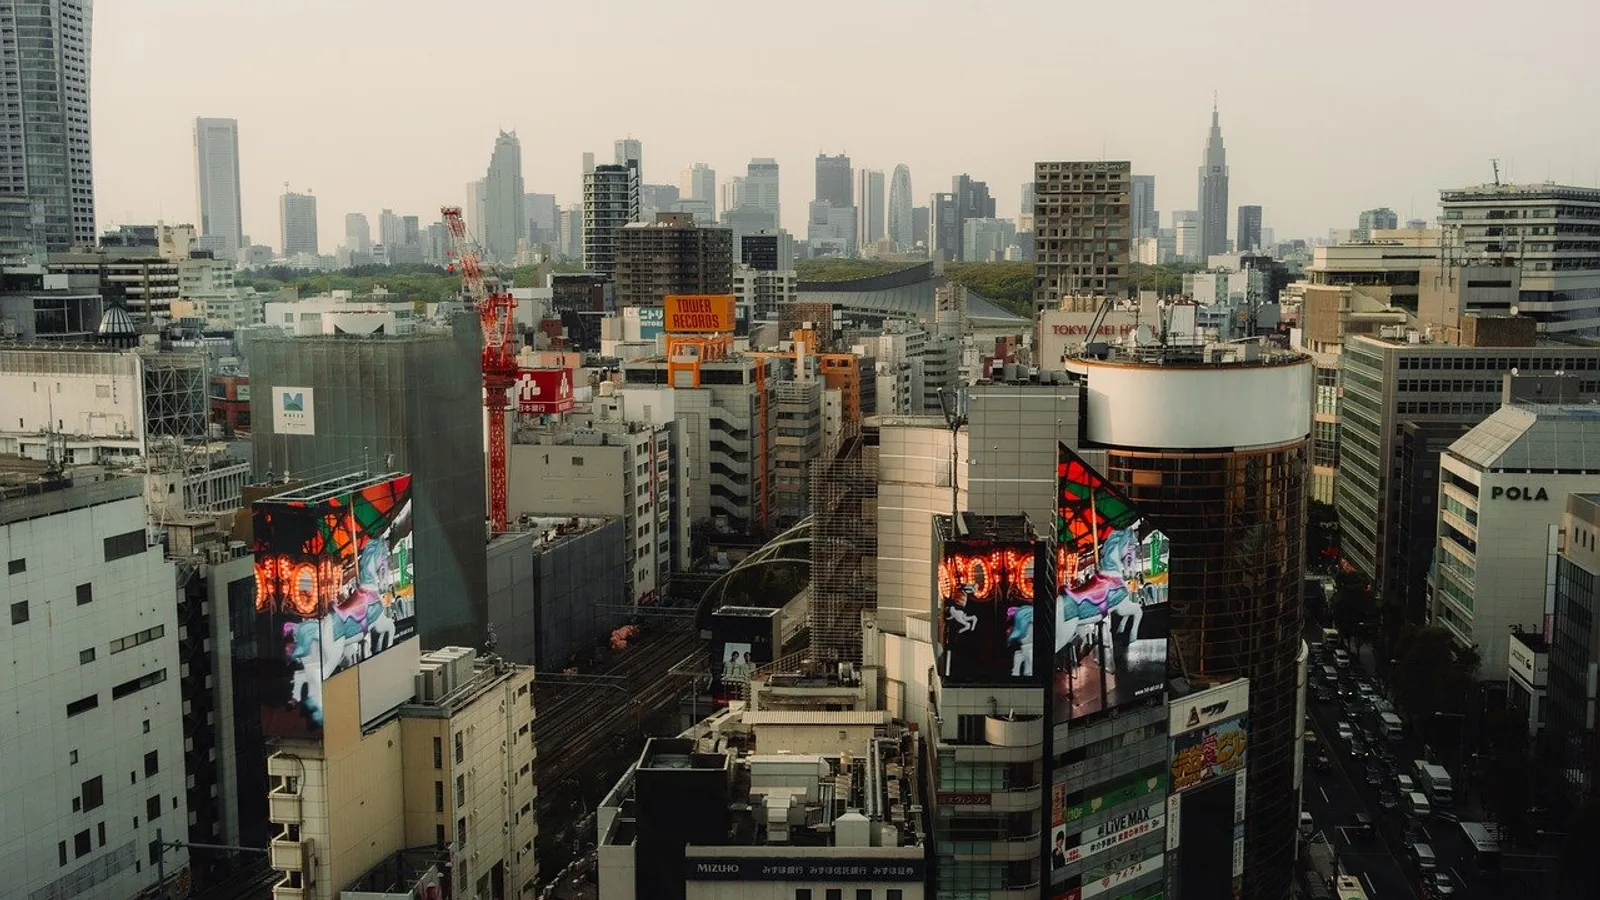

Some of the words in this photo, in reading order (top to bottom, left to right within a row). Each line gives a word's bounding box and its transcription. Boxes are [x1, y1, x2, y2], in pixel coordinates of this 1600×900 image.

[676, 299, 712, 313] TOWER
[673, 314, 720, 328] RECORDS
[1492, 486, 1548, 500] POLA
[1129, 806, 1150, 826] MAX
[696, 863, 740, 873] MIZUHO
